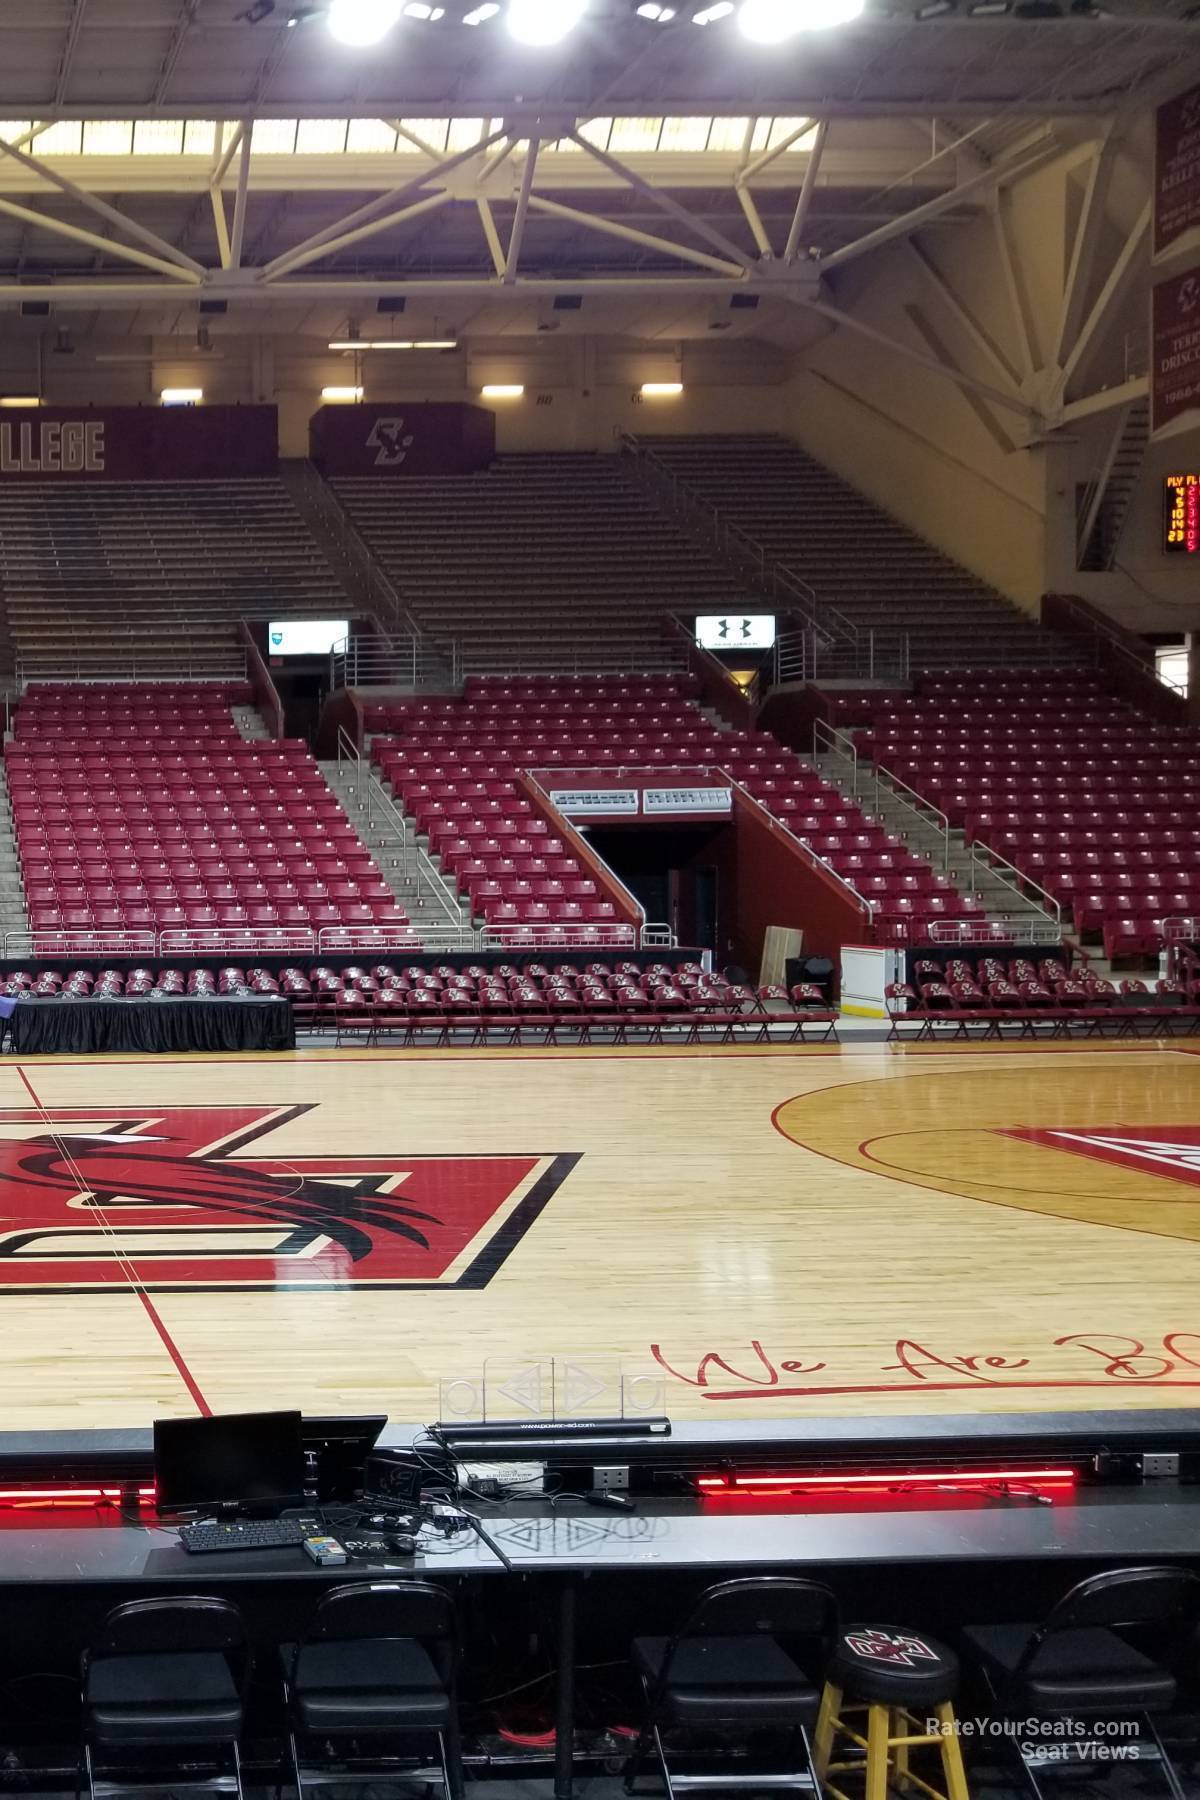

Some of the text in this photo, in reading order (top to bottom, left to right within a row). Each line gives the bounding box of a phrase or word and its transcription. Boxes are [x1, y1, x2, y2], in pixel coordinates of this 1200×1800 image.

[1176, 487, 1184, 497] 4
[1172, 508, 1184, 519] 10
[1171, 519, 1184, 530] 14
[1167, 530, 1184, 542] 23
[650, 1339, 827, 1386] We
[880, 1339, 1031, 1383] Are
